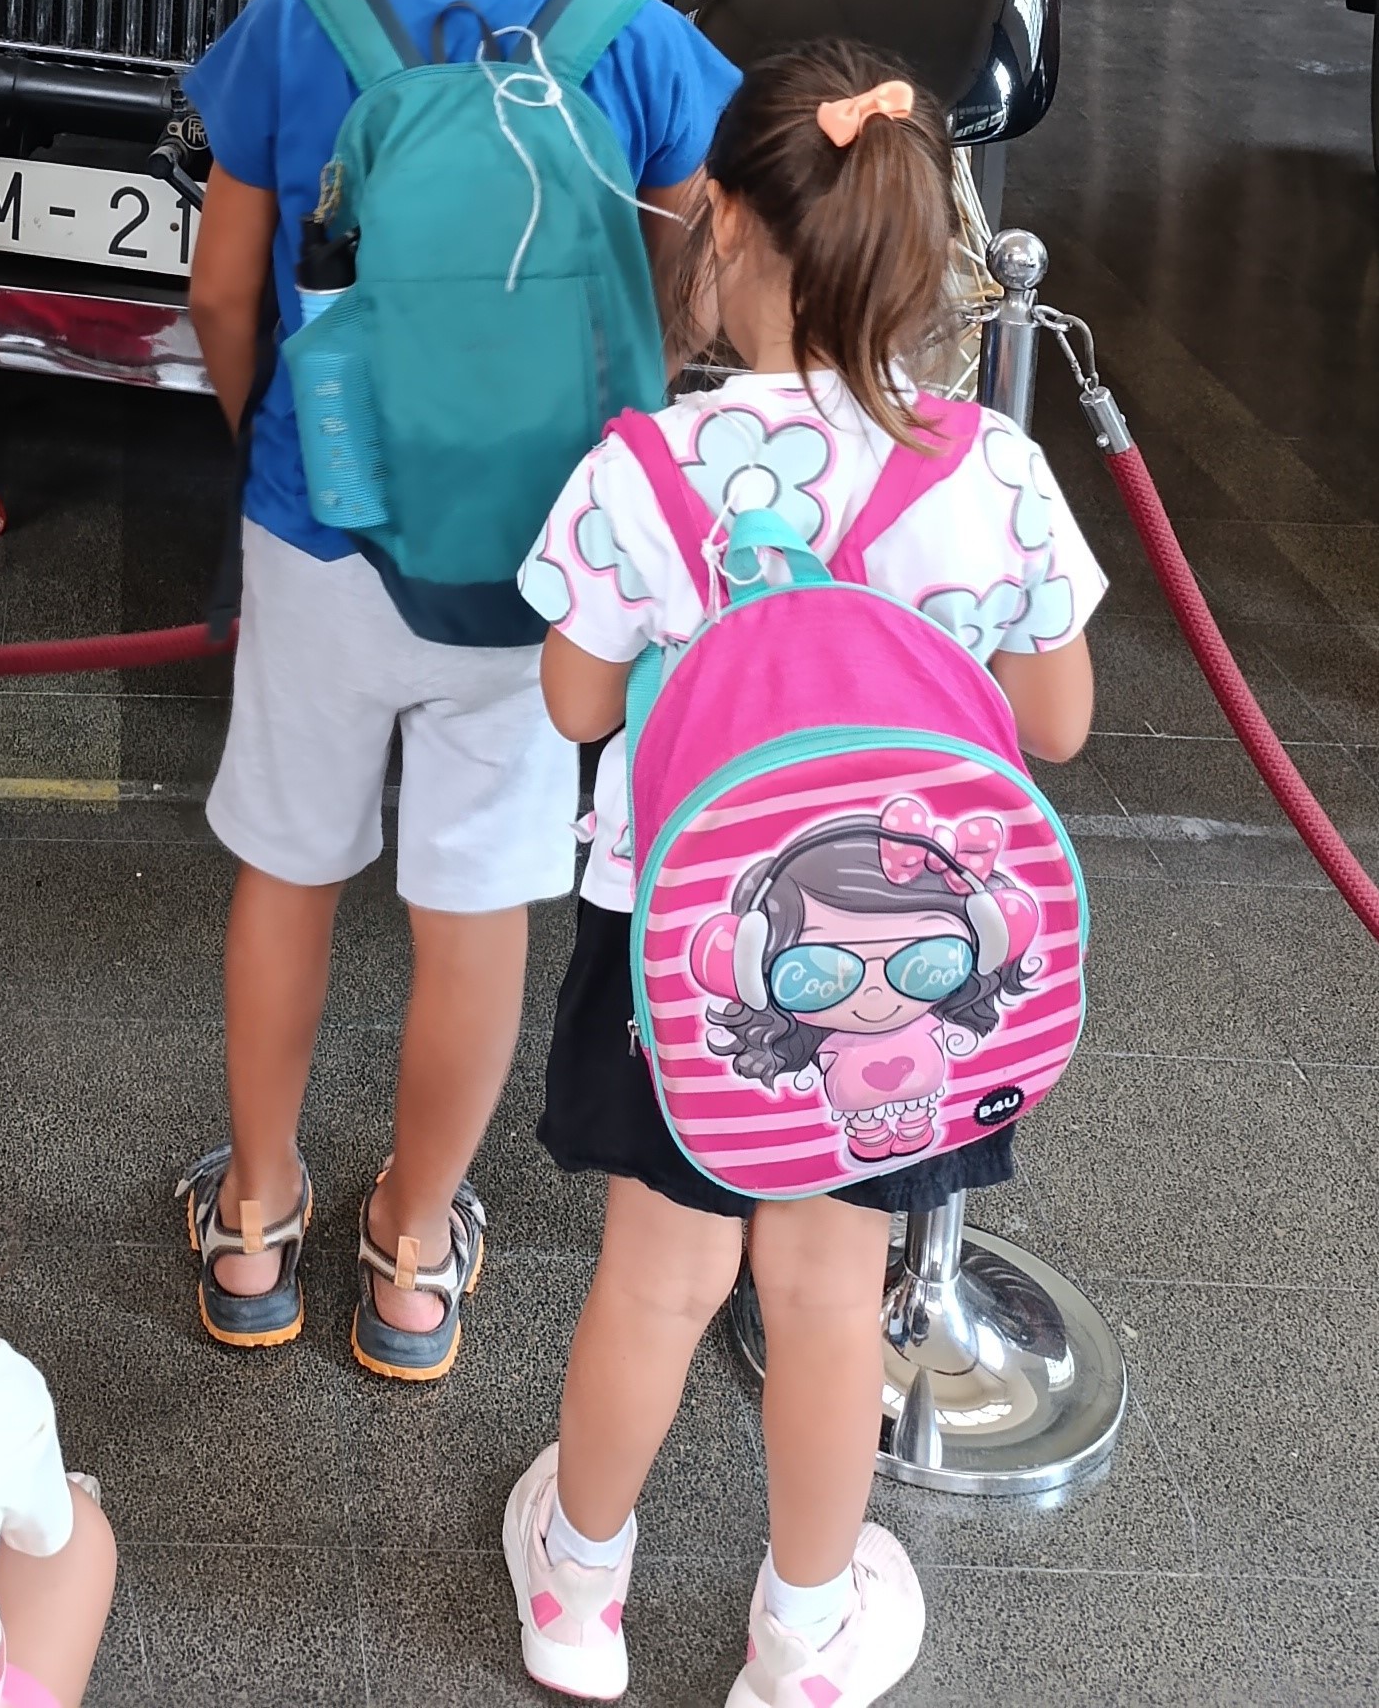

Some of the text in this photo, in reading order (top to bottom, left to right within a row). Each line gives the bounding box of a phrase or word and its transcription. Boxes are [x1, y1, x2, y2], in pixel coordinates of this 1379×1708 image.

[775, 941, 967, 1003] Cool Cool
[979, 1093, 1019, 1119] B4U
